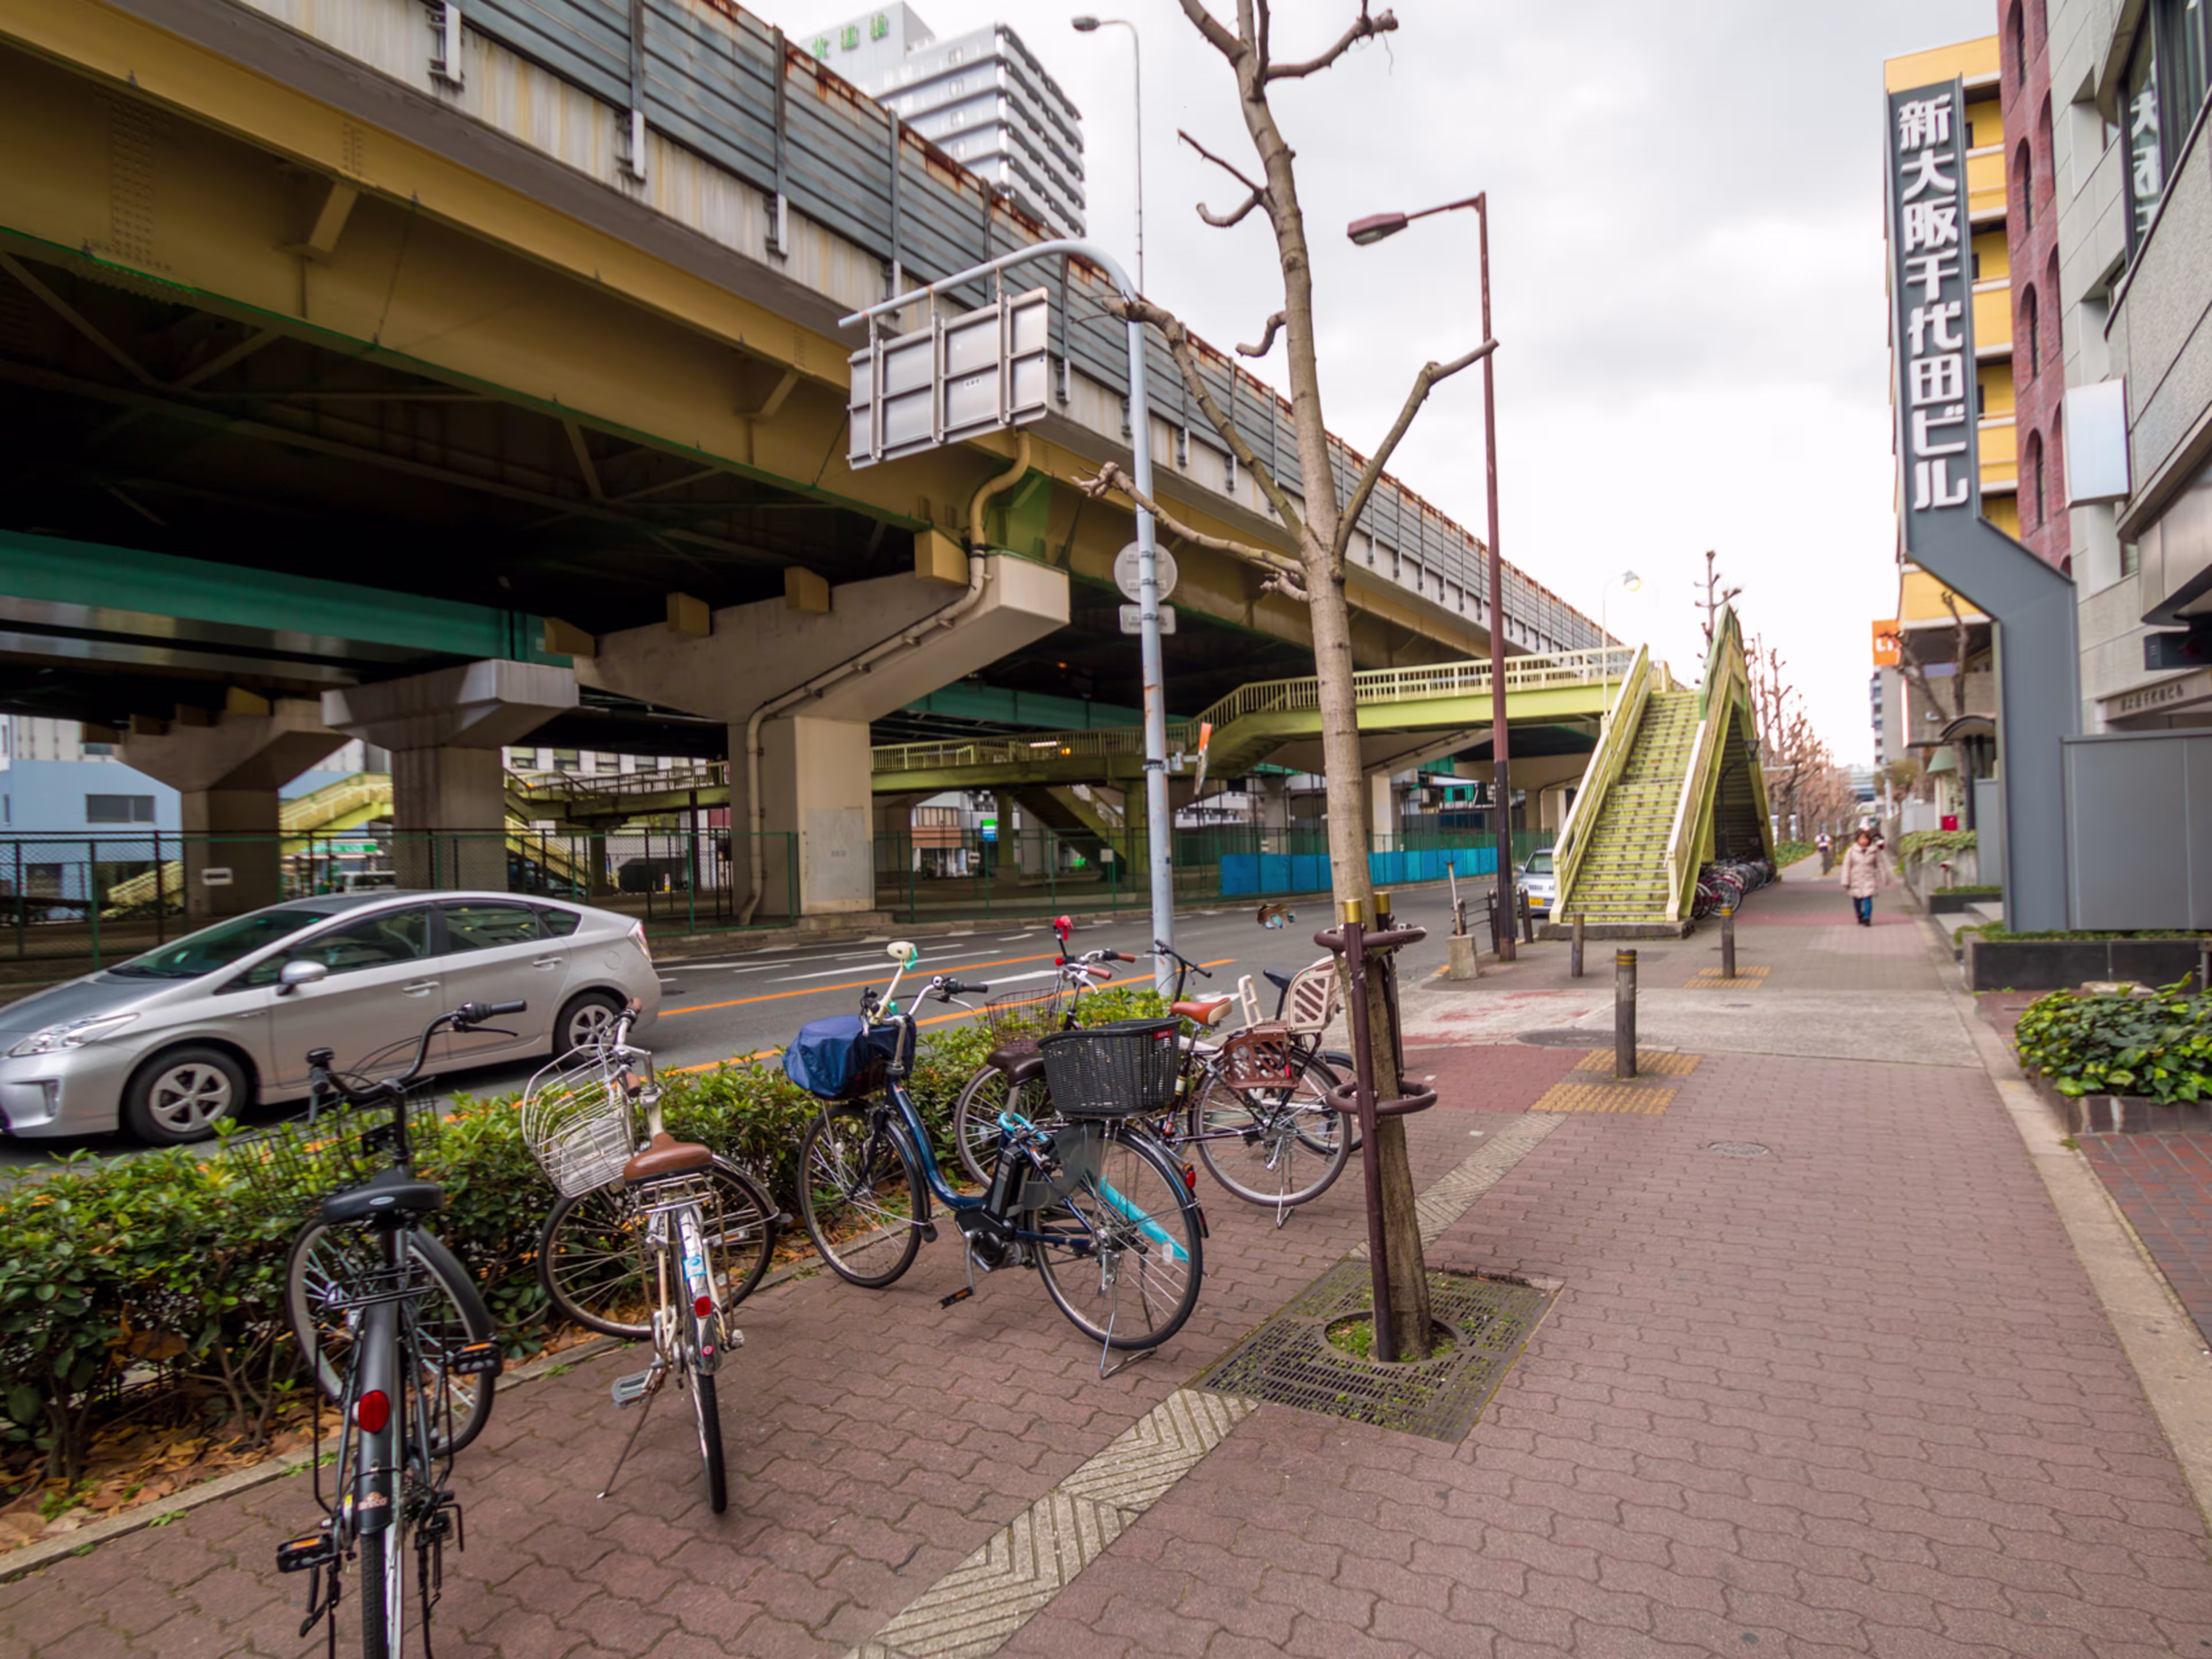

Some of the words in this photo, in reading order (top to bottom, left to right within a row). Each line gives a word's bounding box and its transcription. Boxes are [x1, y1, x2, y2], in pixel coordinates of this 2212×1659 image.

[1898, 92, 1968, 511] 新大阪千代田ビル
